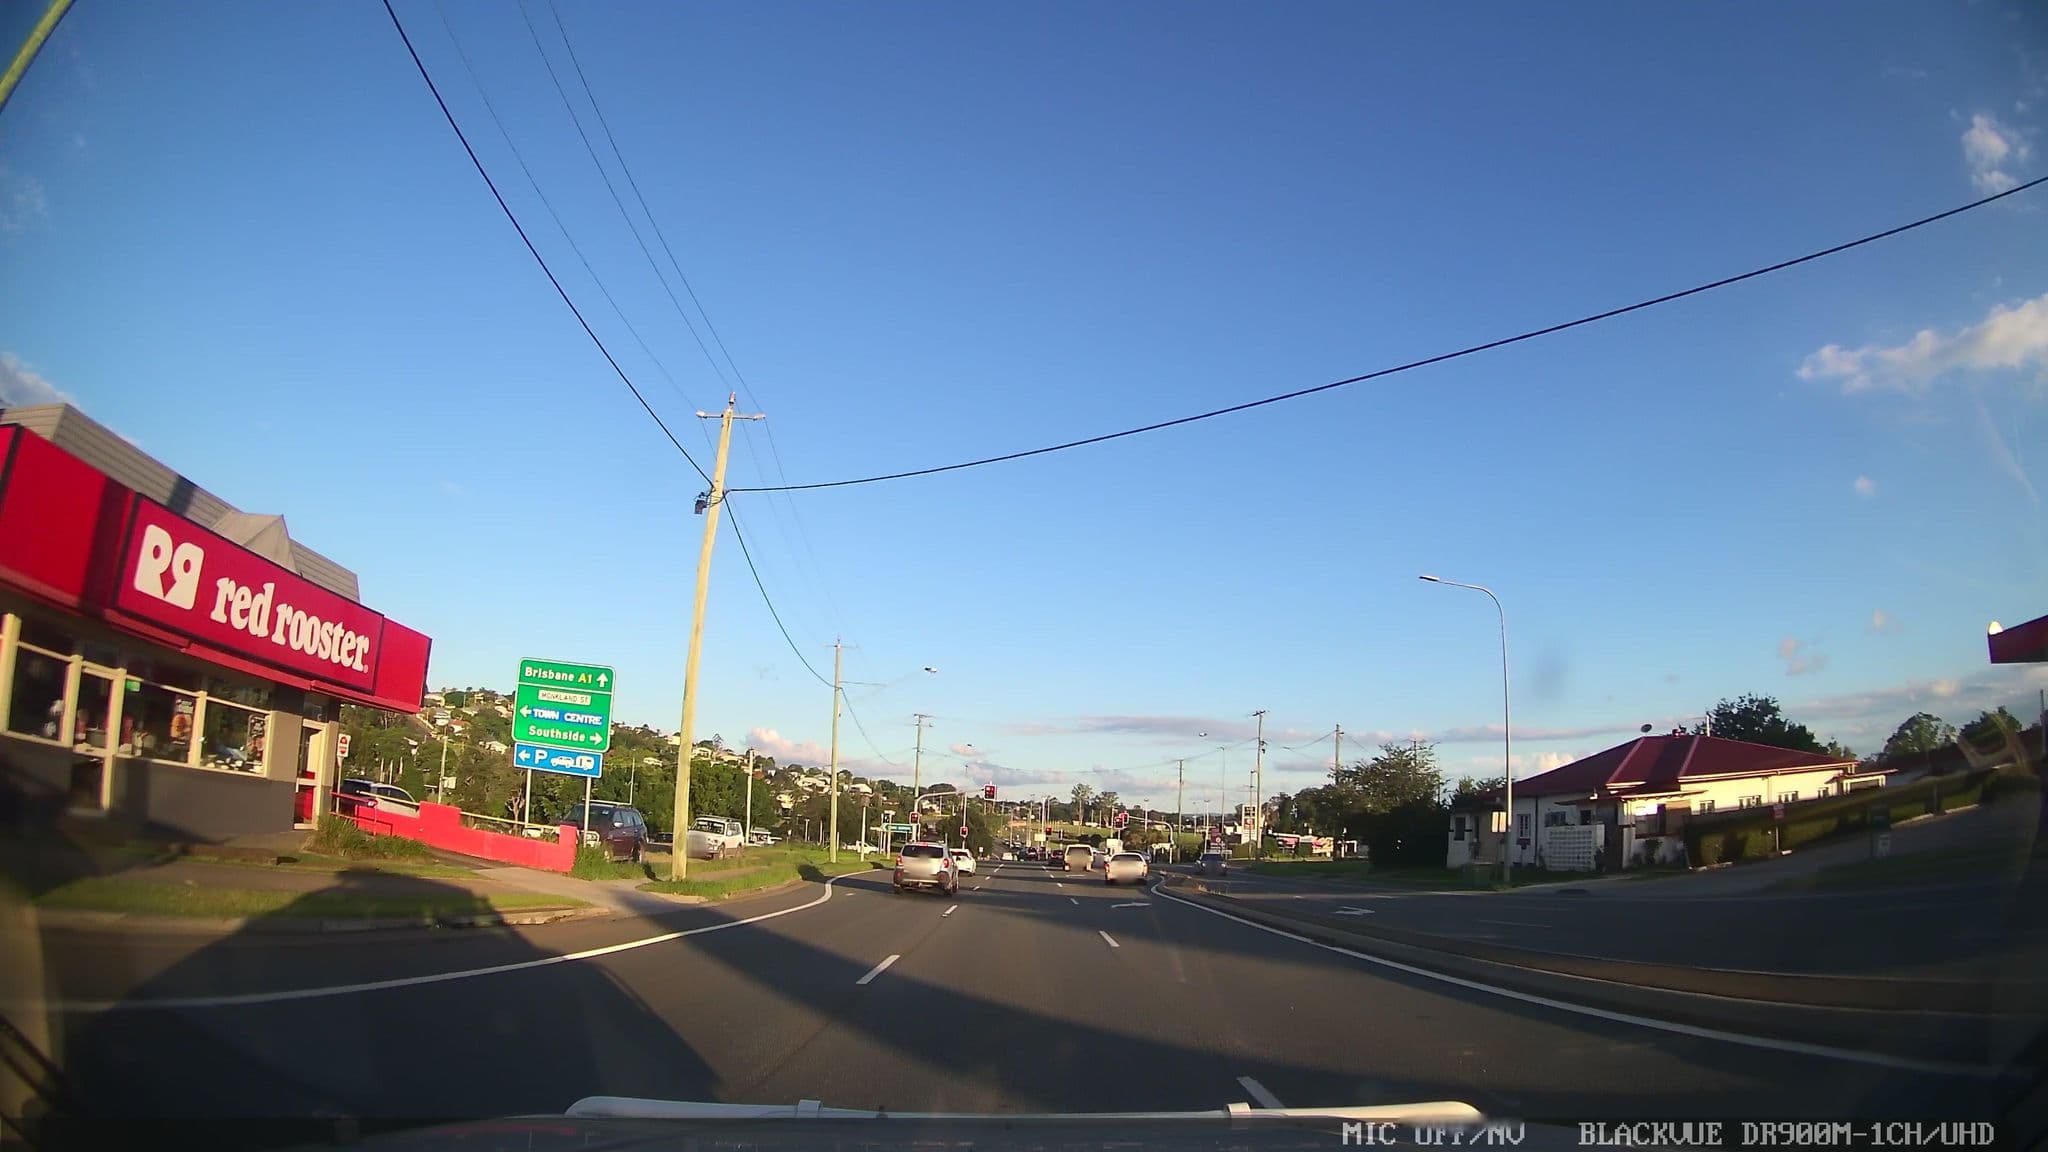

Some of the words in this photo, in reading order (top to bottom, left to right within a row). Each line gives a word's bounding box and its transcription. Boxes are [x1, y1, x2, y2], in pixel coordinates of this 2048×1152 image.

[210, 577, 275, 638] red
[271, 603, 369, 671] rooster
[525, 667, 574, 681] Brisbane
[578, 673, 592, 684] A1
[533, 708, 560, 720] TOWN
[564, 714, 603, 725] CENTRE
[529, 726, 585, 741] Southside
[534, 749, 548, 764] P
